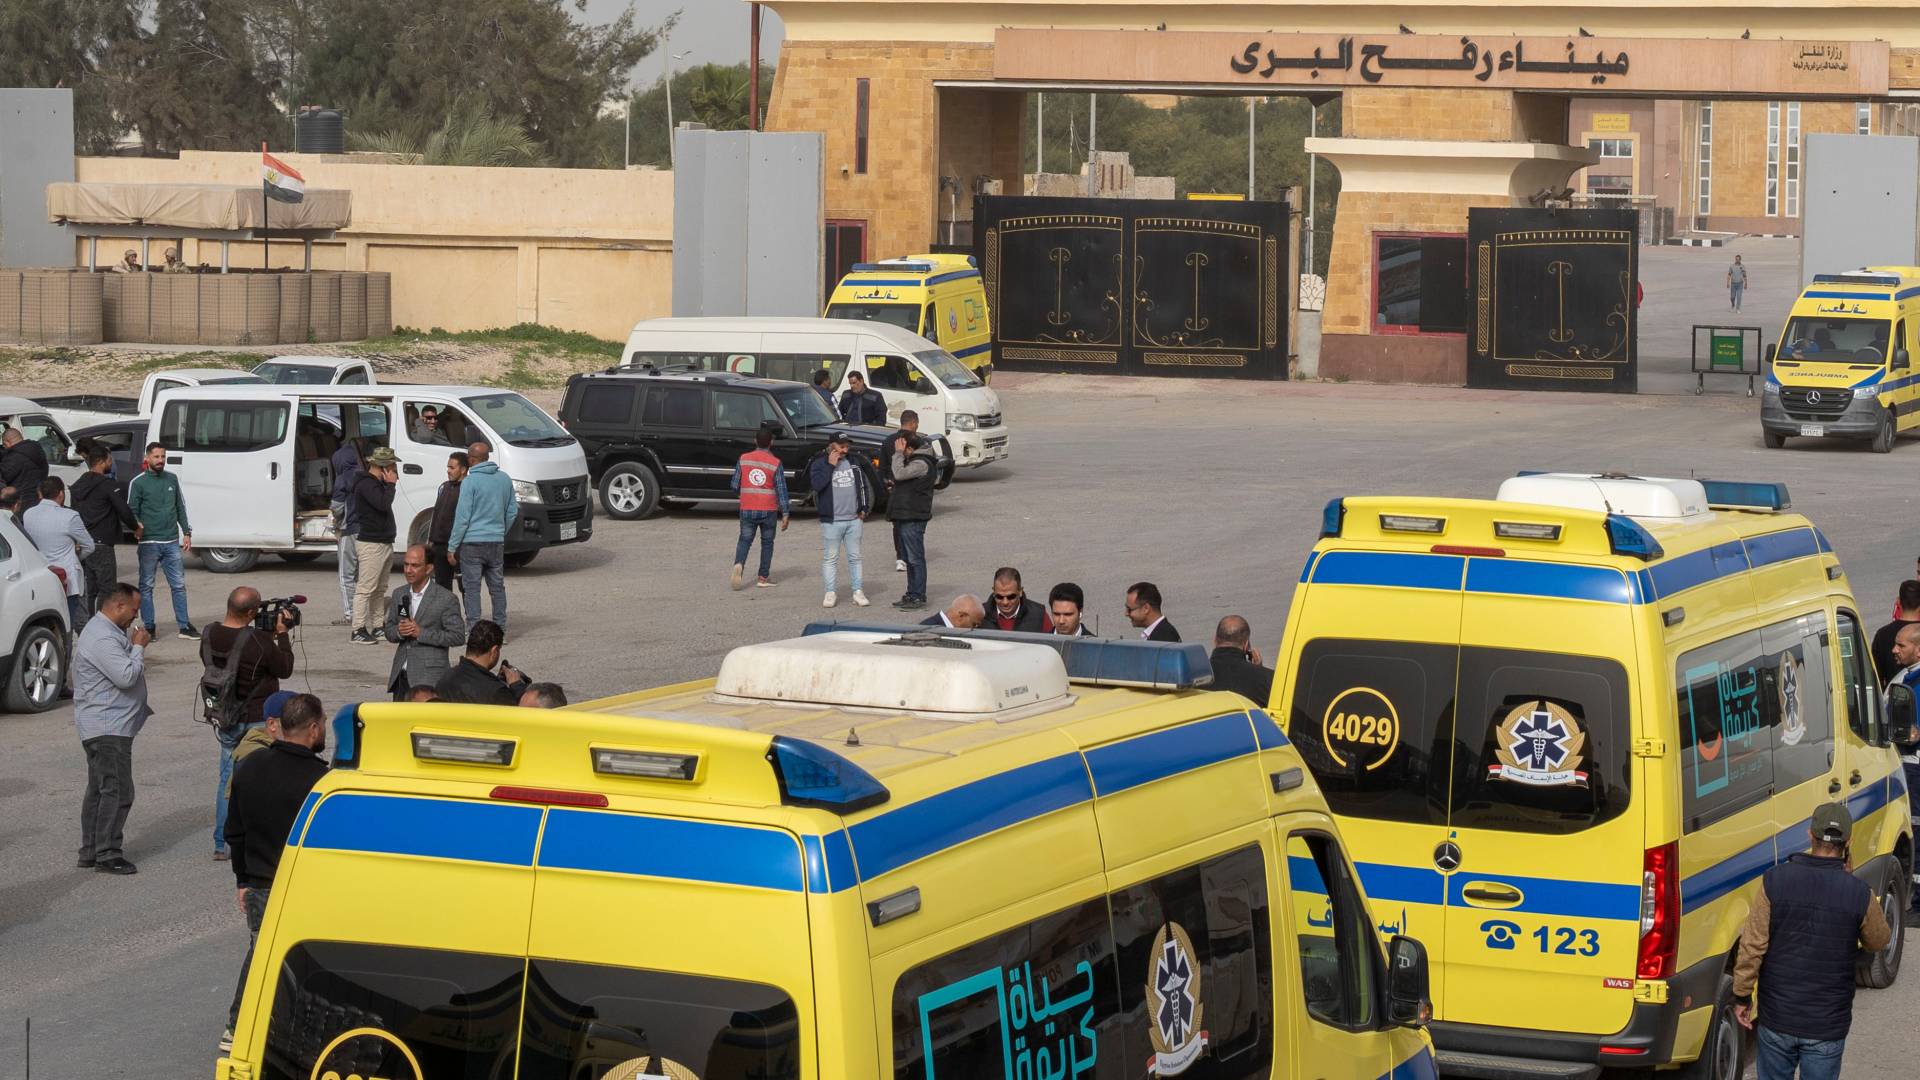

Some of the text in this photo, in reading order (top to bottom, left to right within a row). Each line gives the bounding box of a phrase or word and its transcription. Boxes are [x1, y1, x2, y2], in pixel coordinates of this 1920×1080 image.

[1360, 35, 1493, 83] رفح
[1498, 40, 1630, 85] ميناء
[1329, 712, 1392, 746] 4029
[1533, 926, 1600, 957] 123
[1606, 978, 1630, 988] WAS
